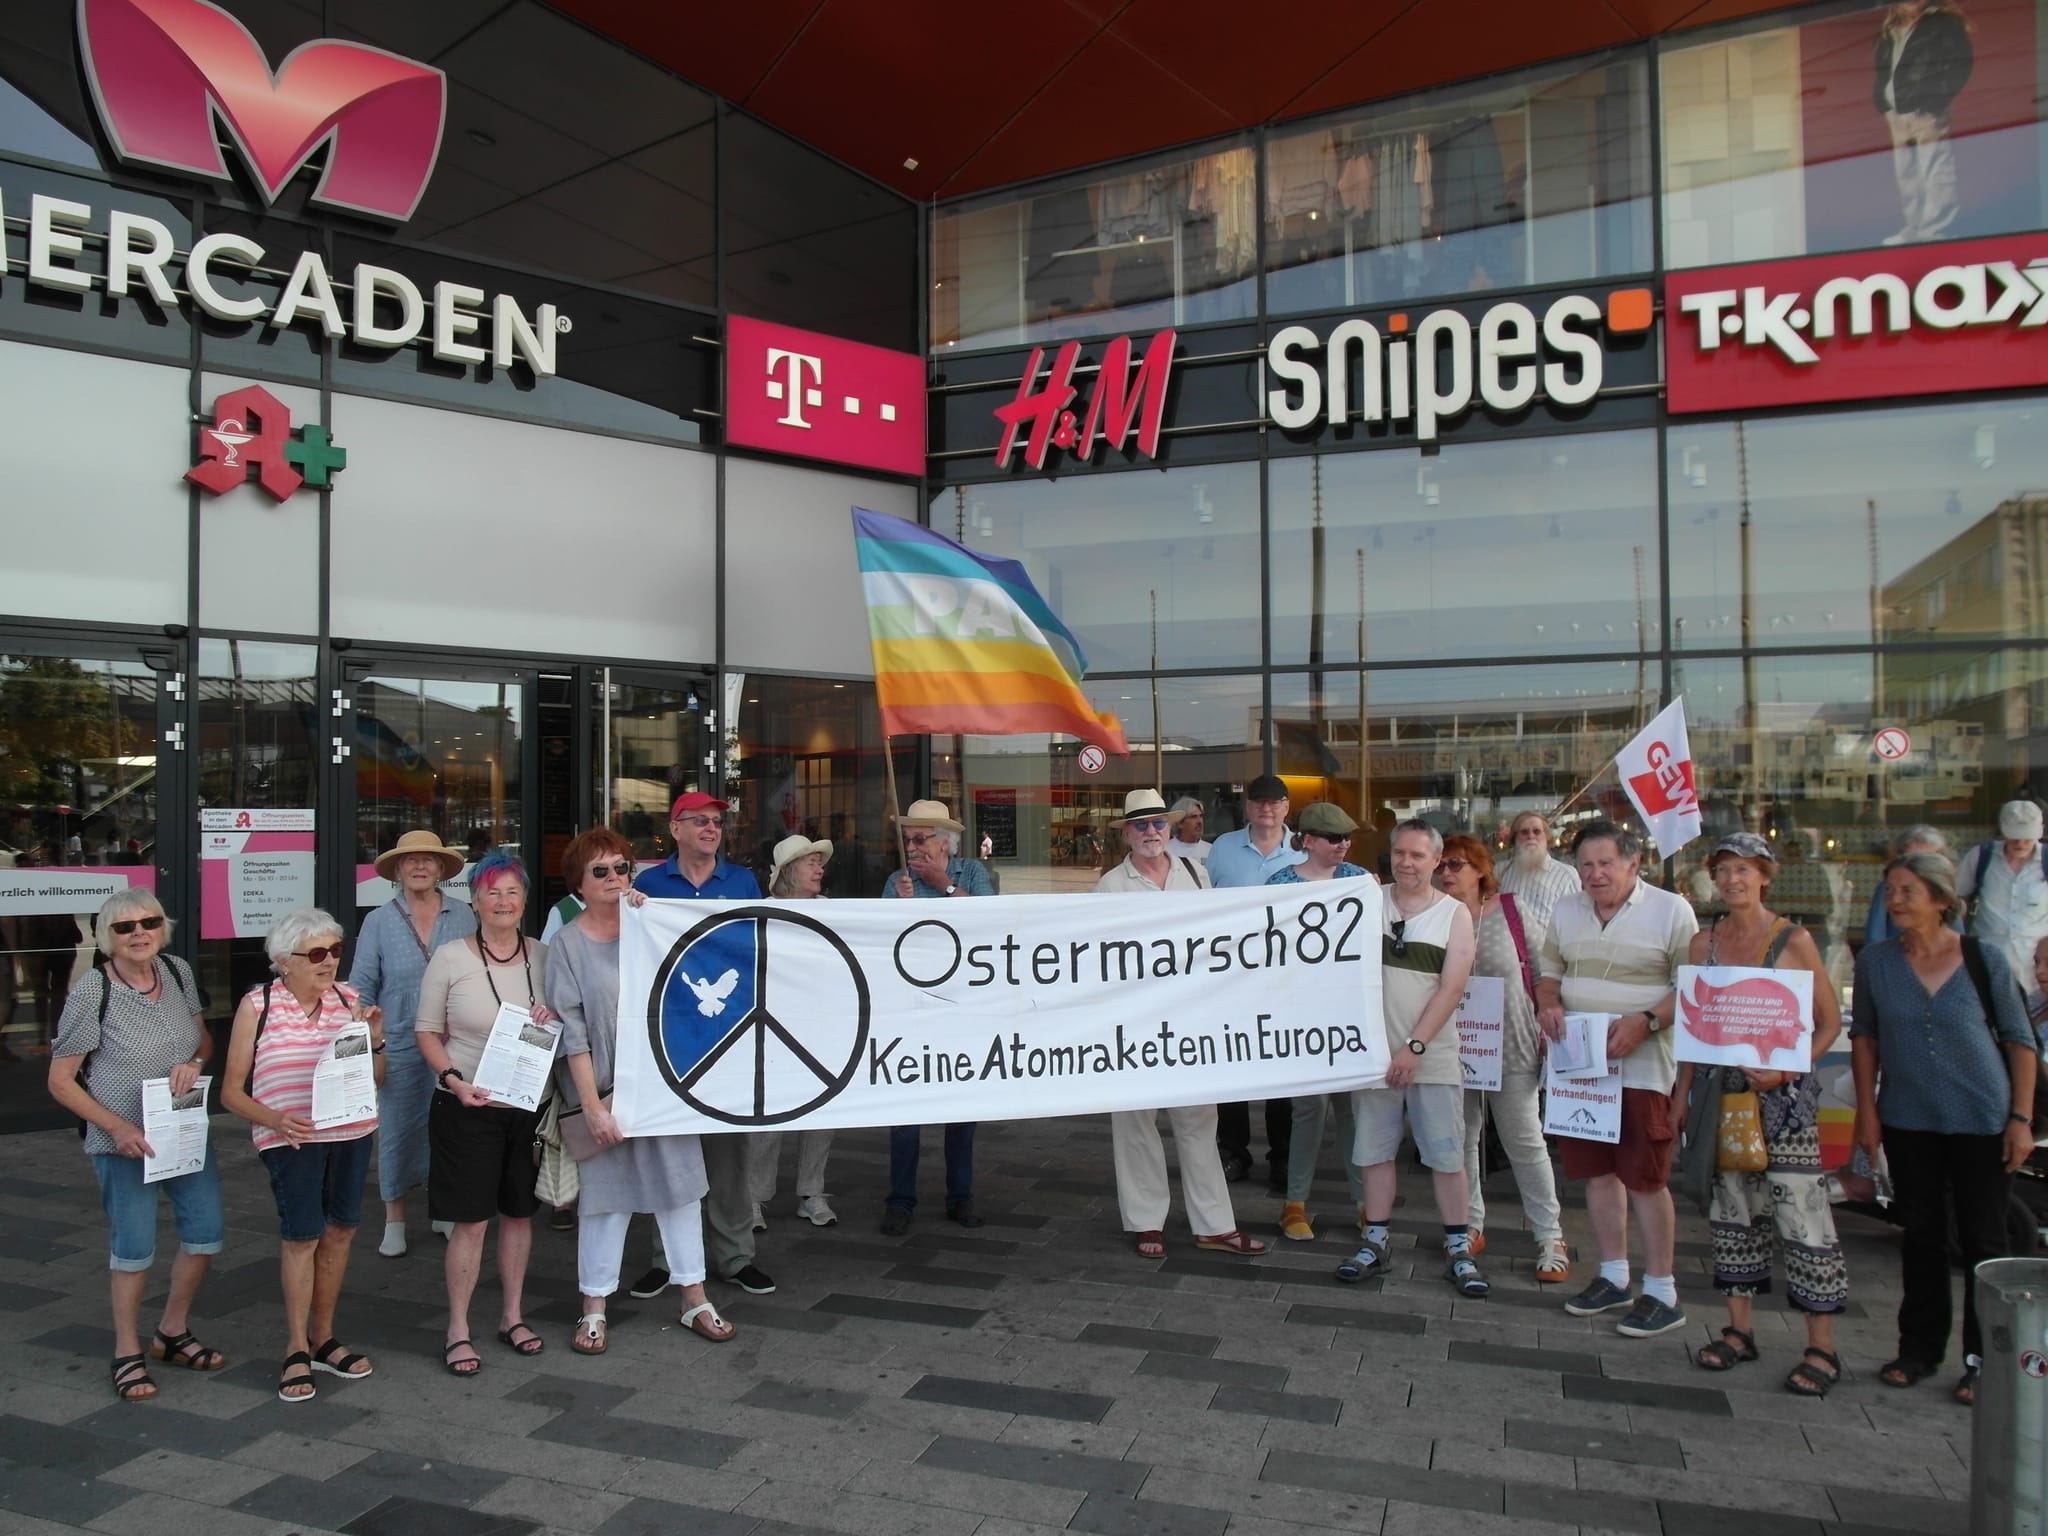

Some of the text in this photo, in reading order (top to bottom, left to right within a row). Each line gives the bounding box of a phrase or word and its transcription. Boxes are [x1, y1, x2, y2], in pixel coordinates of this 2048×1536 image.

[1268, 295, 1603, 440] snipes
[994, 328, 1178, 470] H&M
[38, 885, 114, 897] willkommen!
[1456, 1020, 1501, 1032] stillstand
[869, 1014, 1367, 1086] Keine Atomraketen in Europa
[1458, 1045, 1498, 1058] dlungen!
[1551, 1086, 1617, 1105] Verhandlungen!
[1581, 1126, 1602, 1137] Frieden
